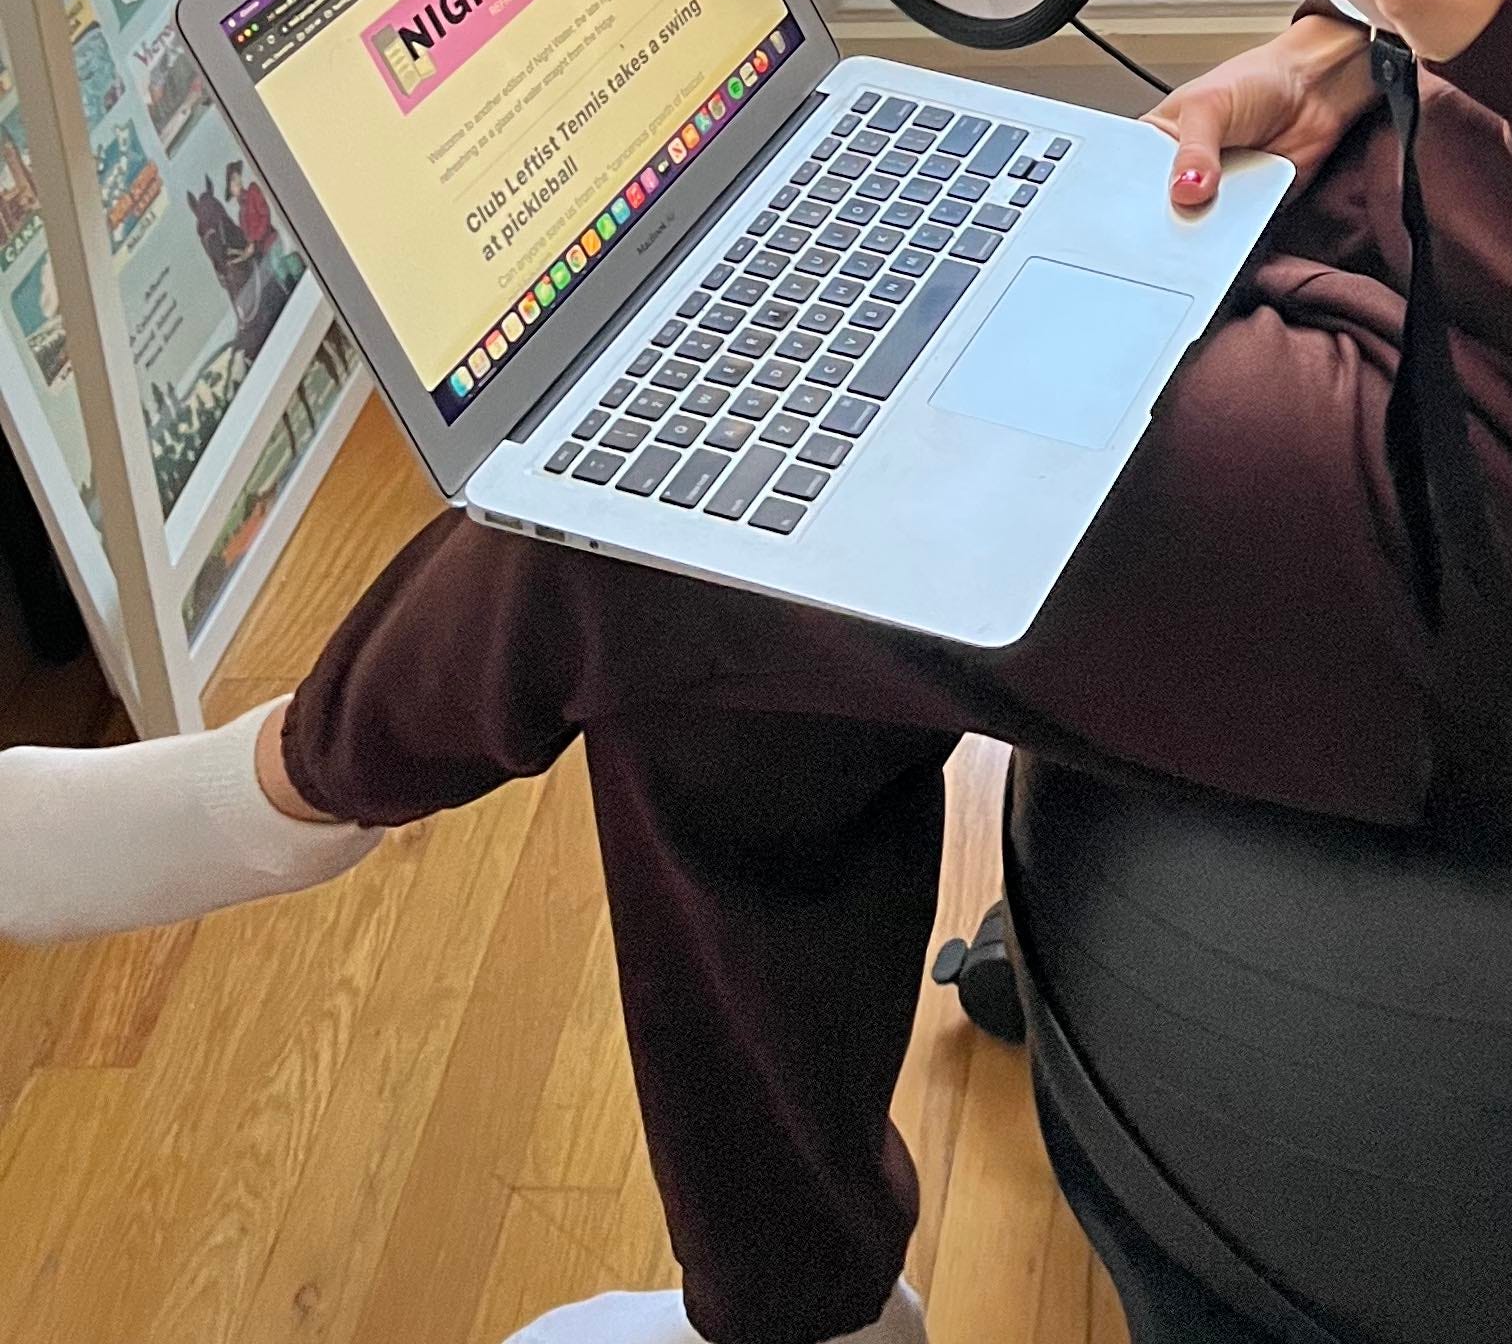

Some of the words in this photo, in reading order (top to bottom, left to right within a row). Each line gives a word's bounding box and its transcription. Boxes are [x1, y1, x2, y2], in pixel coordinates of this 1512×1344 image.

[566, 41, 586, 61] from
[582, 30, 598, 46] the
[427, 126, 466, 164] Welcome
[462, 118, 475, 131] to
[471, 92, 503, 123] another
[499, 69, 528, 96] edition
[523, 60, 536, 73] of
[531, 43, 556, 67] Night
[466, 189, 507, 233] Club
[505, 138, 561, 195] Leftist
[556, 89, 610, 143] Tennis
[608, 48, 649, 94] takes
[649, 38, 660, 55] a
[483, 234, 502, 262] at
[501, 154, 579, 249] pickleball
[511, 234, 549, 271] anyone
[543, 214, 567, 238] save
[562, 204, 578, 219] us
[573, 184, 597, 208] from
[590, 169, 610, 189] the
[637, 224, 666, 256] MacBook
